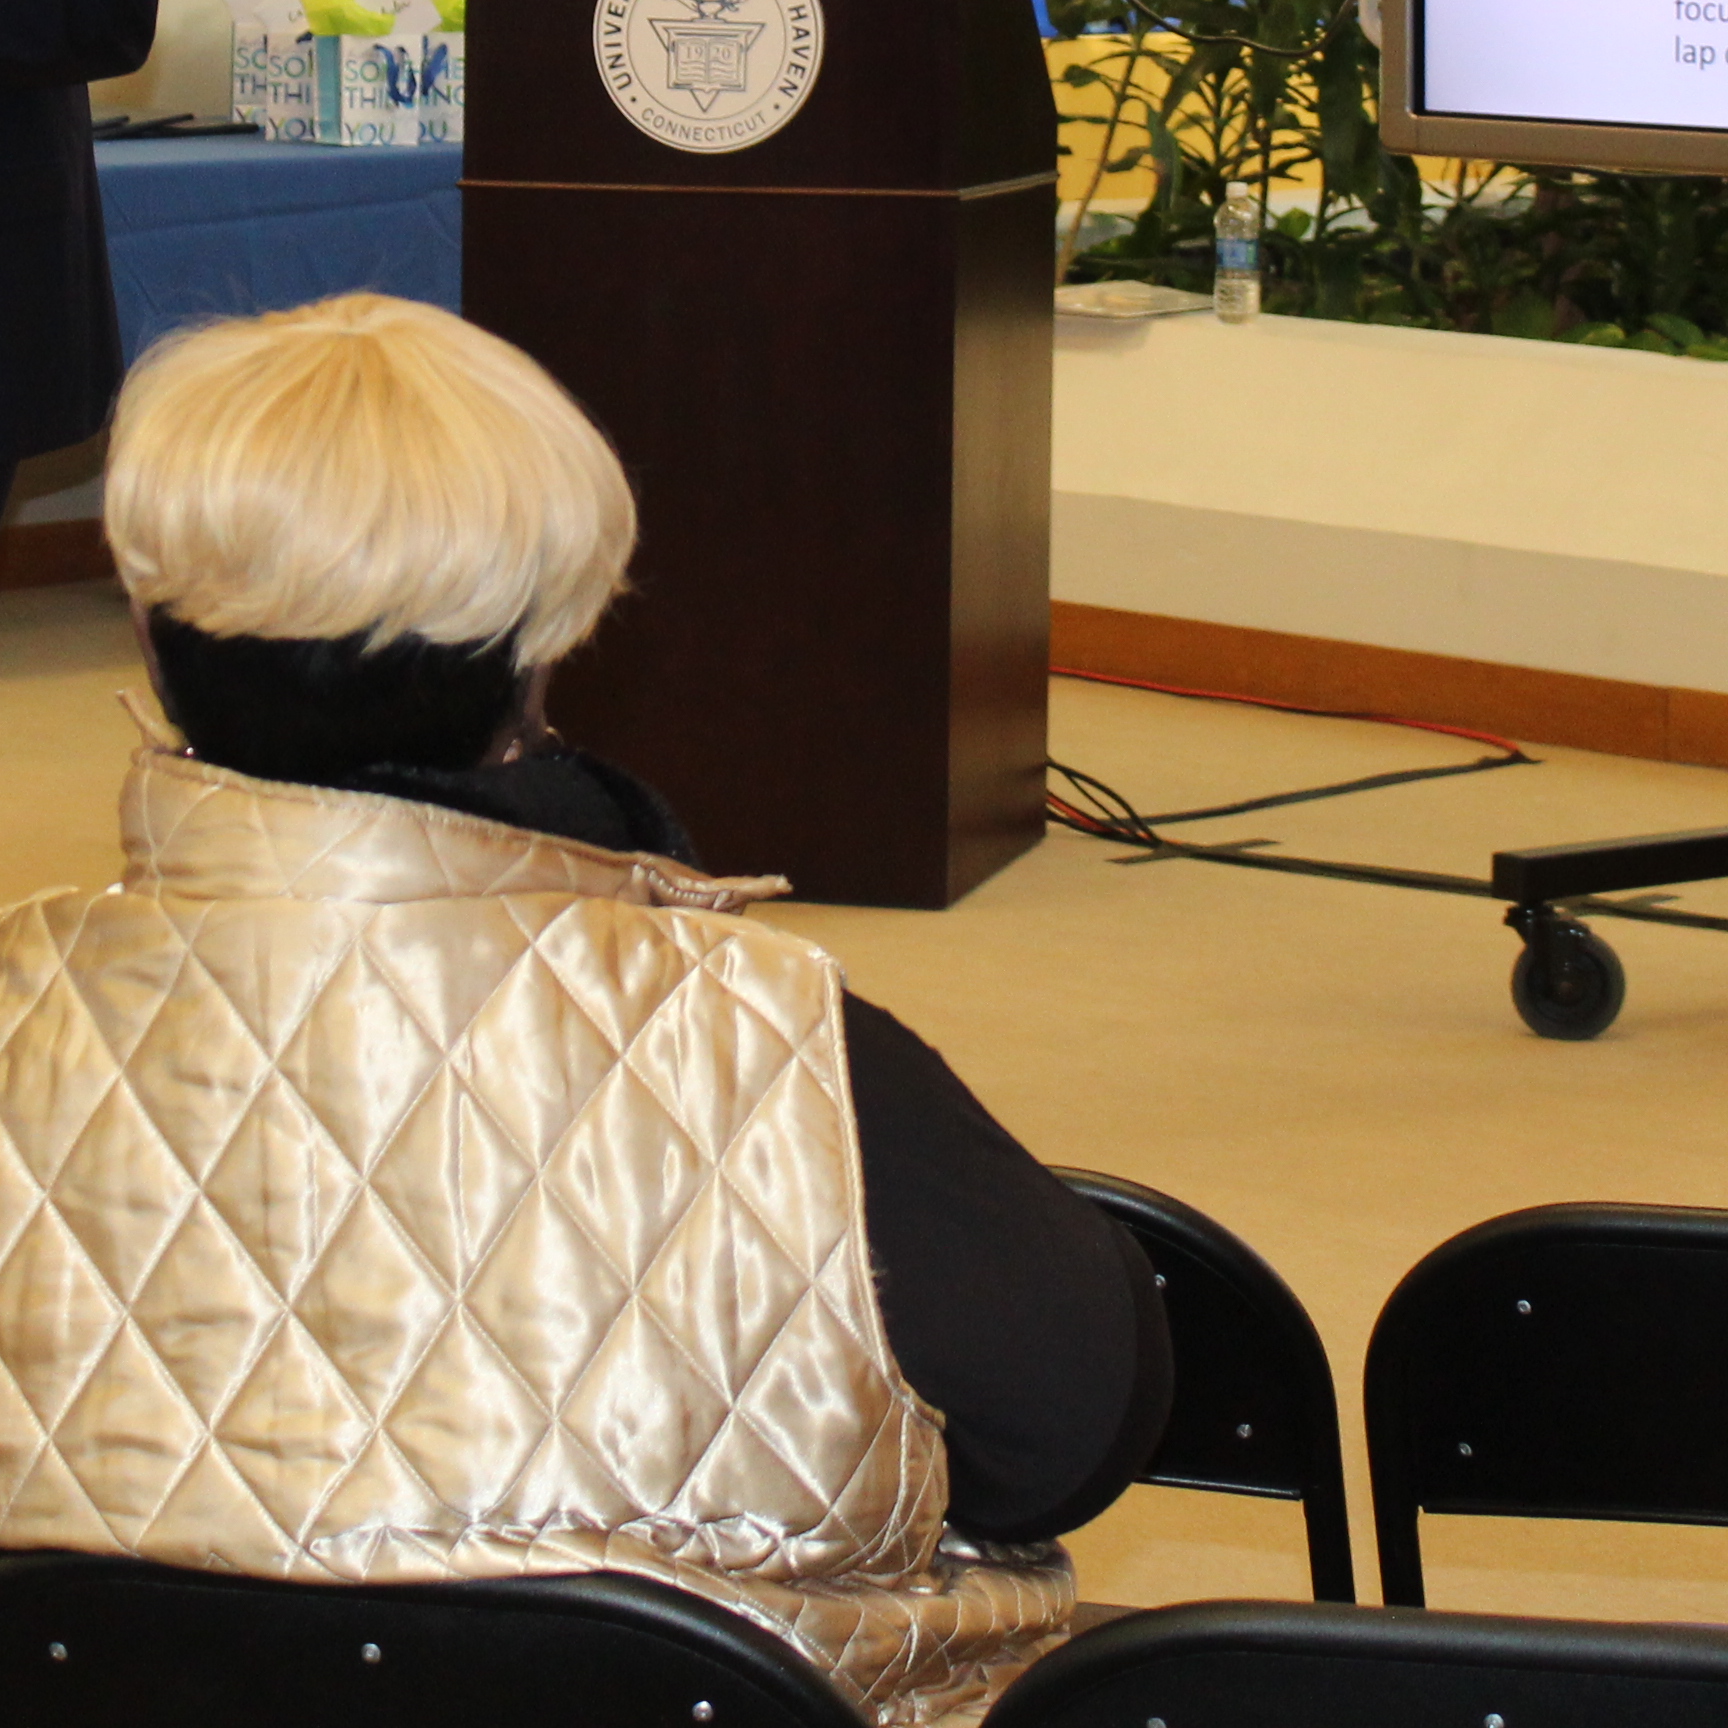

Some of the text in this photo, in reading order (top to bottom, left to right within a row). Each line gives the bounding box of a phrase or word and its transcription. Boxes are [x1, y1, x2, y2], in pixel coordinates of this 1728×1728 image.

[778, 3, 809, 100] HAVEN
[1675, 34, 1717, 71] lap
[344, 121, 396, 146] YOU
[640, 107, 768, 142] CONNECTICUT
